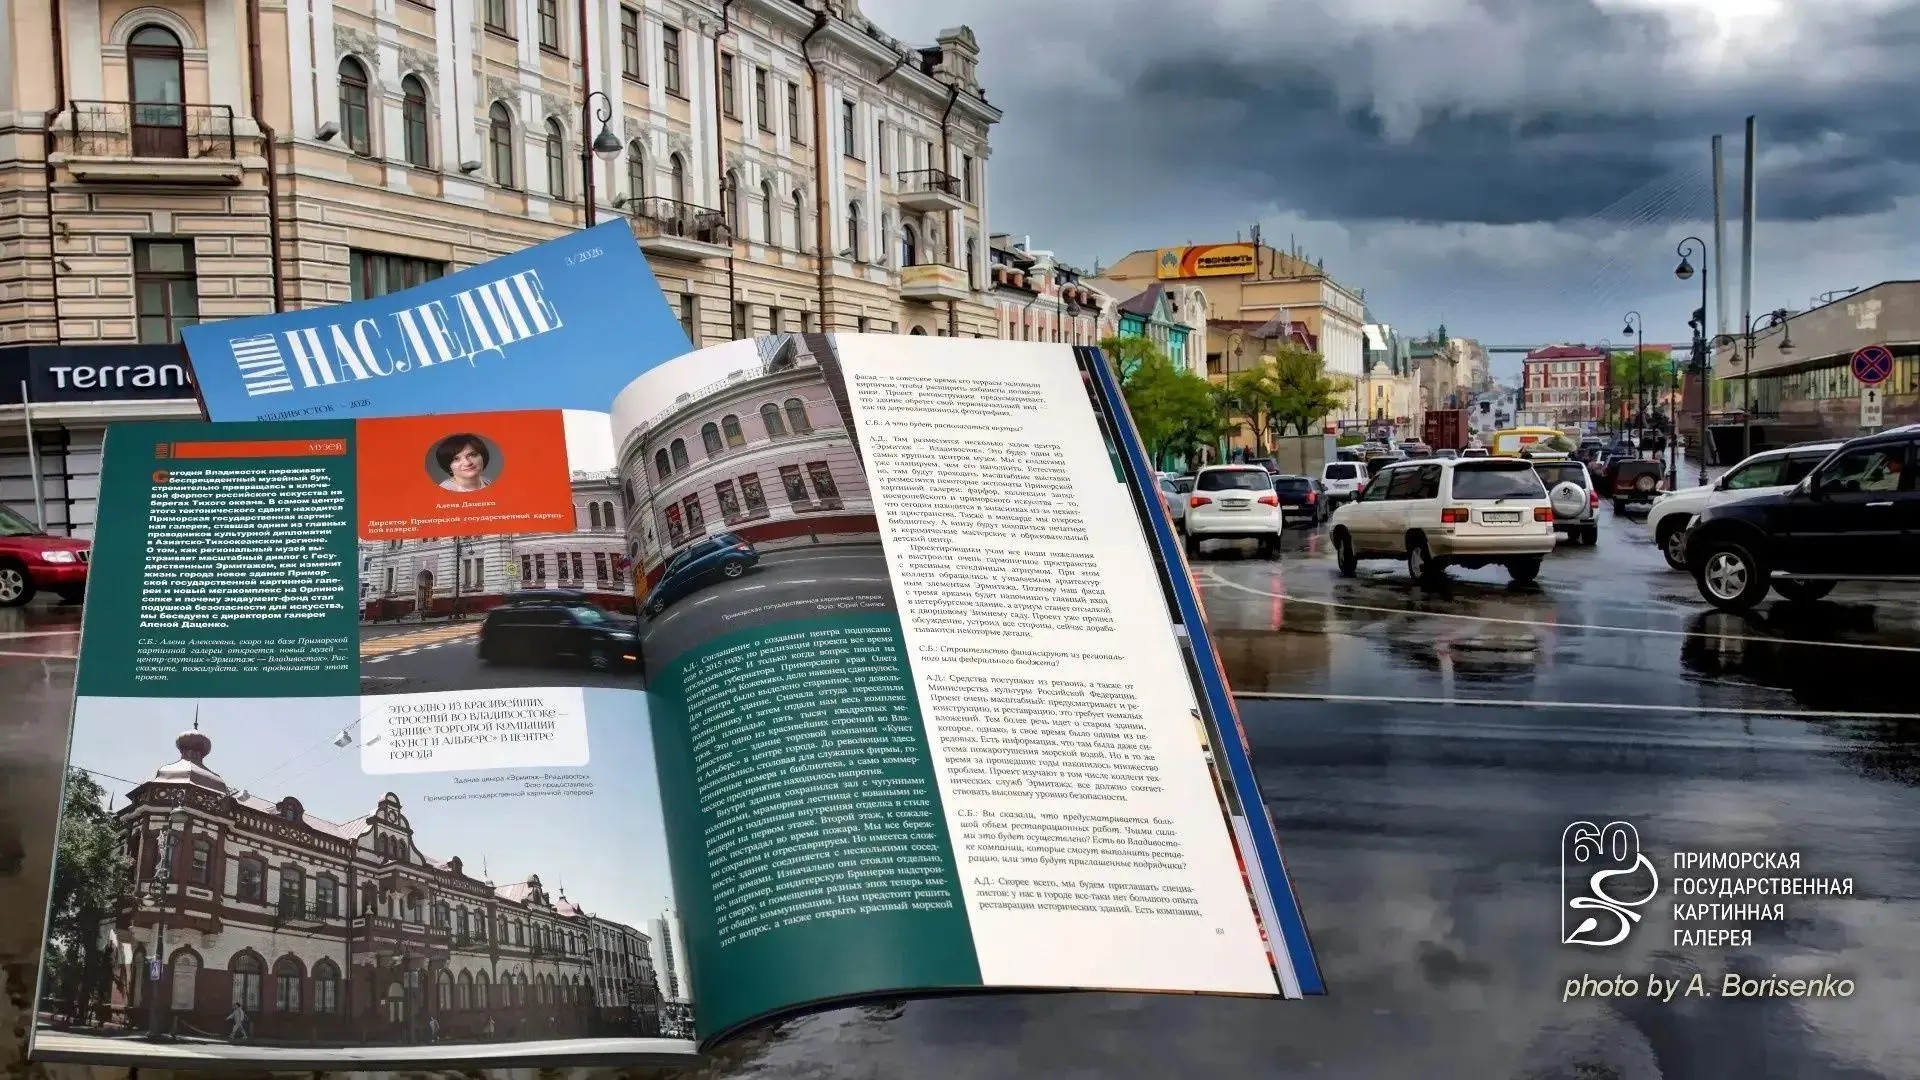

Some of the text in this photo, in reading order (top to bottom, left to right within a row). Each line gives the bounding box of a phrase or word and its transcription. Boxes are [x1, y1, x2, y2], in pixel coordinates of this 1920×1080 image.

[282, 268, 563, 389] НАСЛЕДИЕ
[50, 364, 192, 388] Terran
[257, 404, 334, 422] ВЛАДИВОСТОК
[410, 516, 460, 525] Приморской
[297, 636, 348, 645] Приморской
[716, 802, 745, 817] Внутри
[750, 792, 781, 805] здания
[784, 783, 839, 796] сохранился
[871, 778, 925, 787] чугунными
[720, 935, 736, 947] этот
[739, 924, 771, 938] вопрос,
[782, 914, 811, 925] также
[814, 907, 856, 918] открыть
[859, 901, 908, 914] красивый
[911, 900, 952, 910] морской
[730, 916, 756, 929] общие
[760, 900, 835, 919] коммуникации.
[861, 891, 911, 902] предстоит
[914, 890, 950, 899] решить
